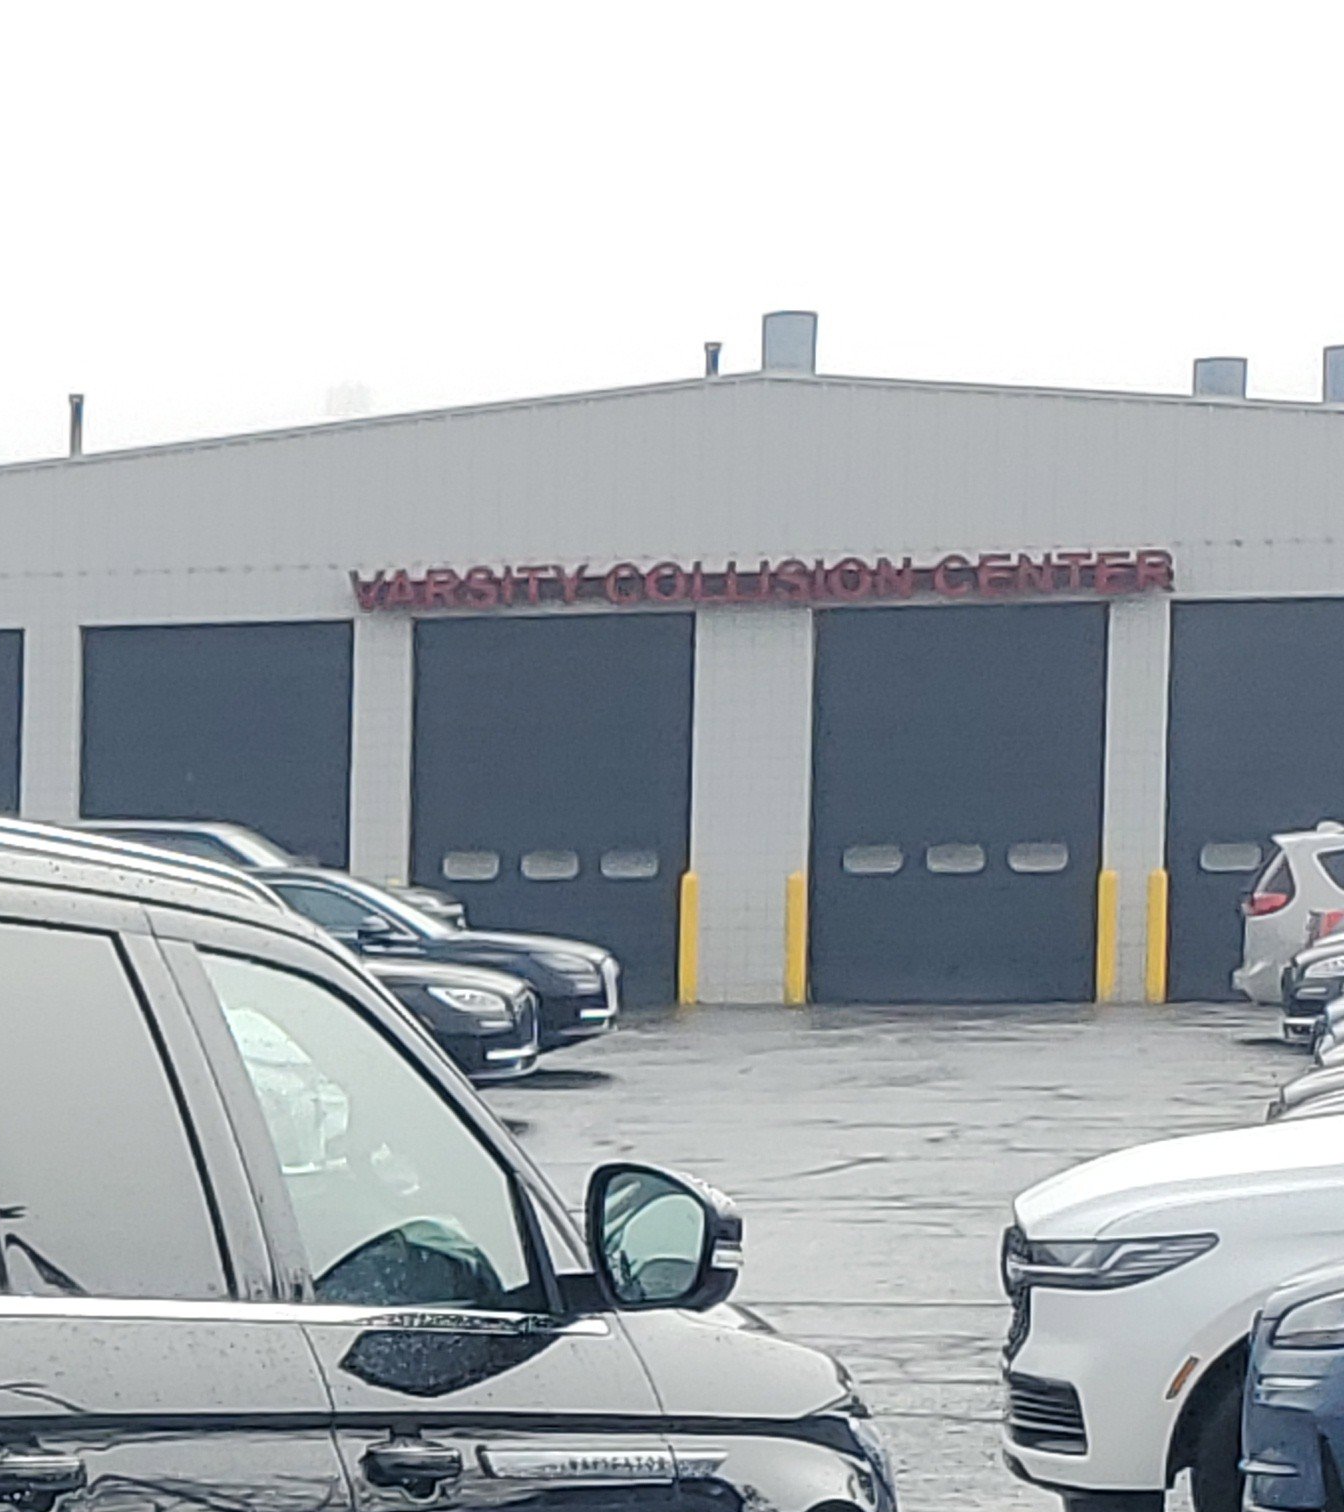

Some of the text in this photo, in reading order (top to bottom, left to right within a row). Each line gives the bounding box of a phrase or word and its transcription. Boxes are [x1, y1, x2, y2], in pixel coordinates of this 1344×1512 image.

[349, 549, 1176, 614] VARSITY COLLISION CENTER
